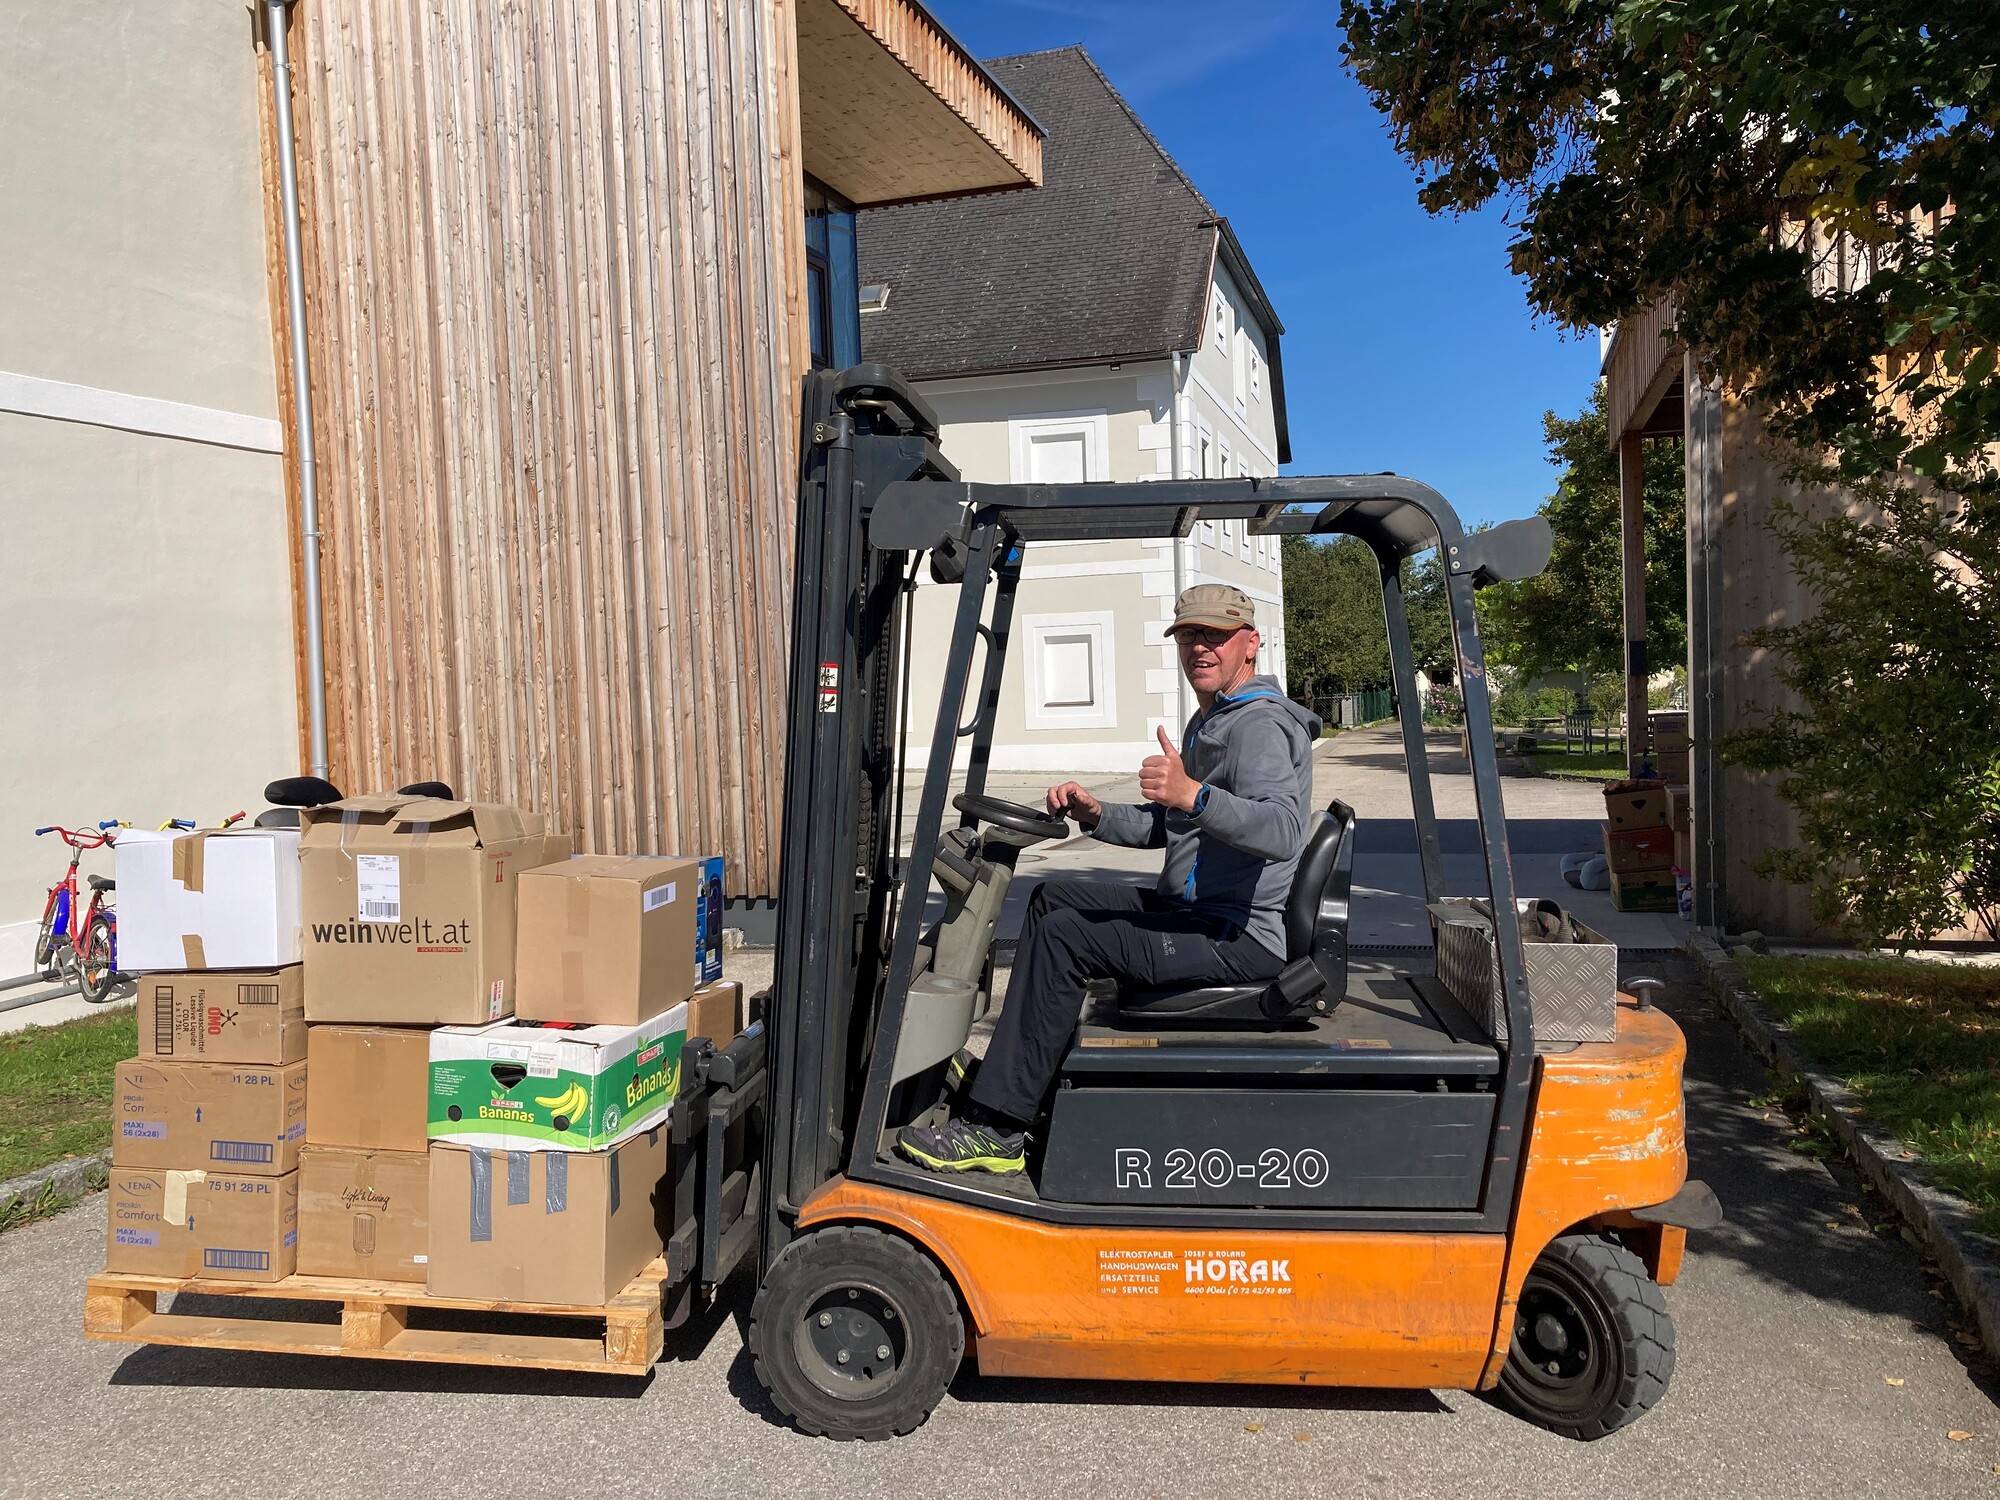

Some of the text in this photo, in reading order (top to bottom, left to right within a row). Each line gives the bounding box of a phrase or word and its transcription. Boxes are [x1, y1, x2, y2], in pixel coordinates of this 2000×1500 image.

[311, 916, 472, 944] weinwelt.at
[182, 1009, 190, 1033] COLOR
[207, 1006, 221, 1036] OMO
[245, 1075, 257, 1085] 28
[260, 1076, 275, 1086] PL
[626, 1066, 672, 1108] Bananas
[479, 1105, 535, 1123] Bananas
[123, 1121, 144, 1129] MAXI
[134, 1130, 160, 1138] (2x28)
[1115, 1148, 1330, 1189] R 20-20
[127, 1181, 152, 1191] TENA
[209, 1180, 271, 1194] 75 91 28 PL
[116, 1209, 161, 1222] Comfort
[116, 1228, 137, 1236] MAXI
[116, 1235, 152, 1245] 56 (2x28)
[1100, 1250, 1174, 1259] ELEKTROSTAPLER
[1184, 1250, 1206, 1258] JOSEF
[1216, 1250, 1246, 1258] ROLAND
[1100, 1262, 1179, 1271] HANDHUBWAGEN
[1184, 1259, 1292, 1284] HORAK
[1100, 1274, 1160, 1283] ERSATZTEILE
[1122, 1286, 1159, 1294] SERVICE
[1184, 1286, 1205, 1294] 4600
[1206, 1285, 1226, 1294] Wels
[1240, 1287, 1250, 1295] 72
[1277, 1286, 1292, 1294] 895
